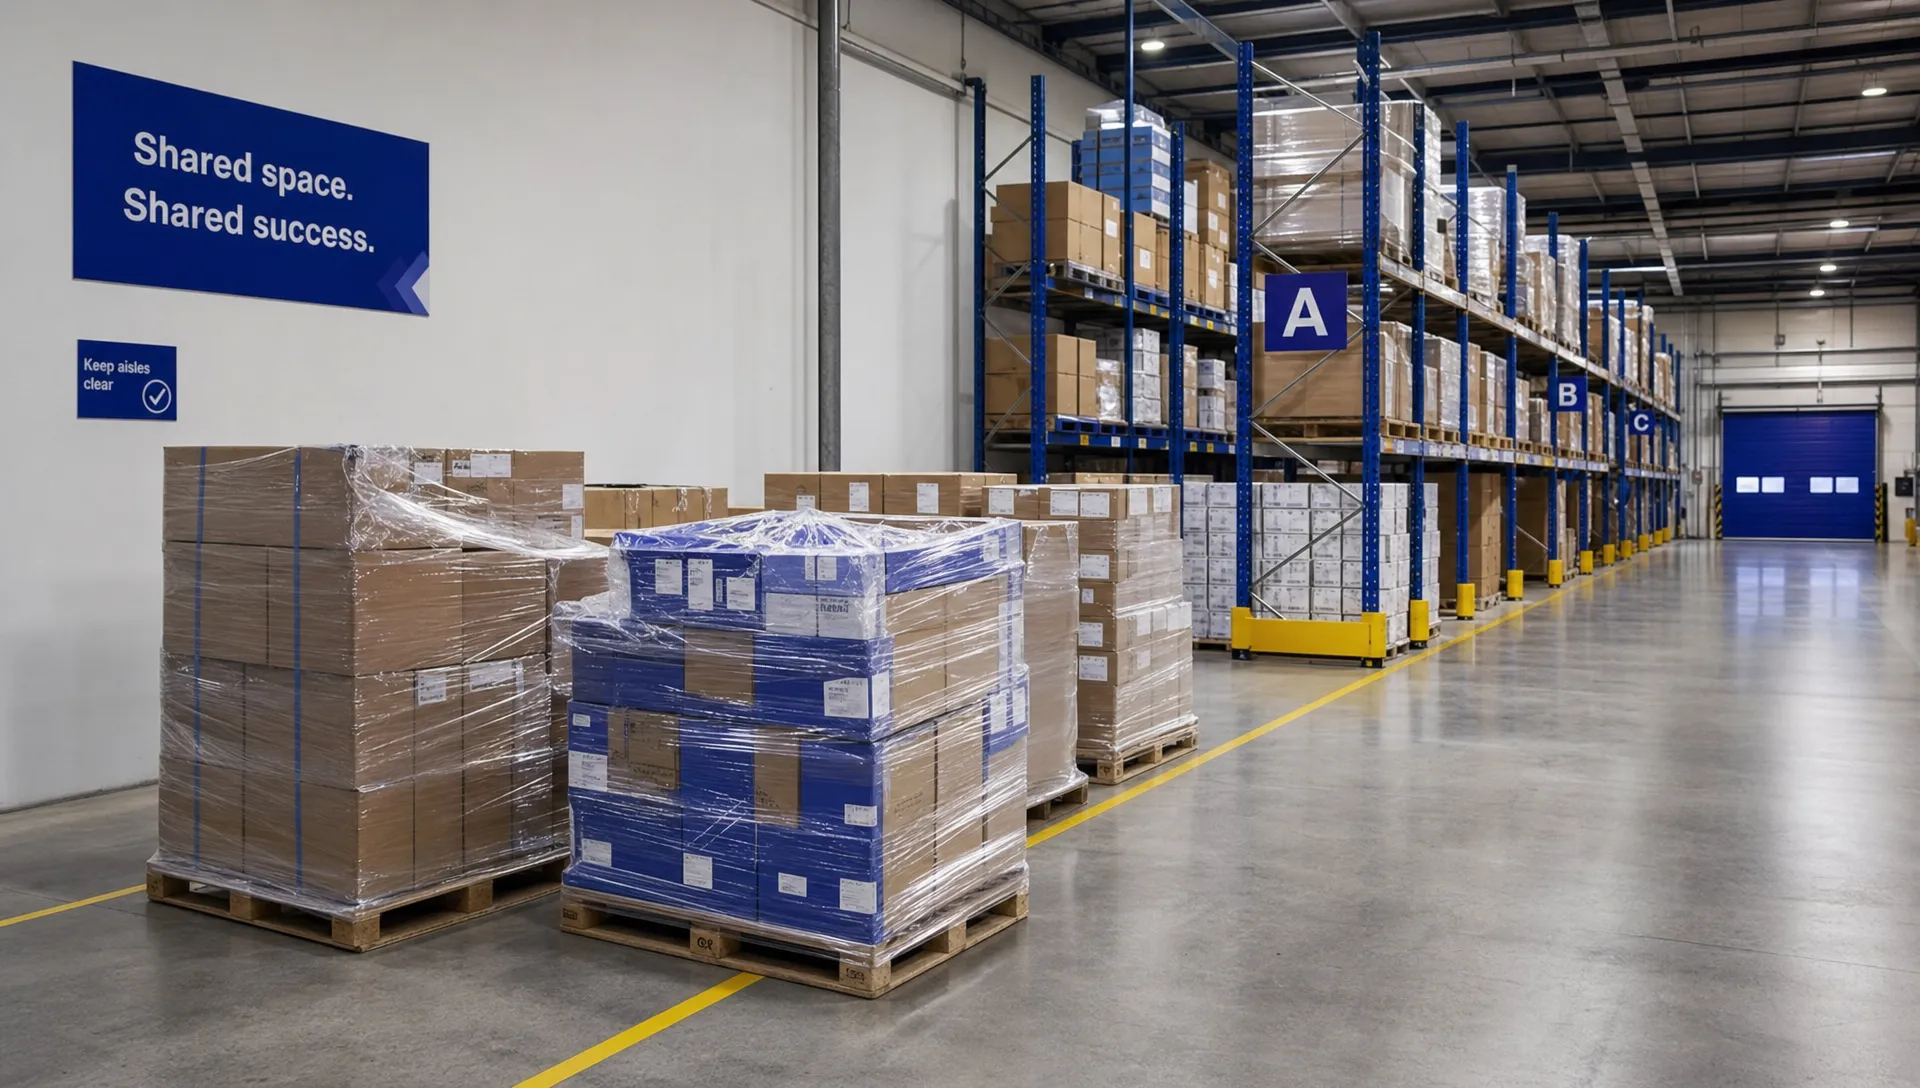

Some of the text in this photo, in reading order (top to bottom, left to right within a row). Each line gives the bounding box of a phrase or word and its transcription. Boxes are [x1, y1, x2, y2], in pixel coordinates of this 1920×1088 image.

[133, 131, 353, 201] Shared space.
[123, 187, 375, 253] Shared success.
[1283, 287, 1329, 338] A
[83, 357, 151, 376] Keep aisles
[83, 376, 114, 391] clear
[1558, 382, 1578, 407] B
[1633, 413, 1650, 432] C
